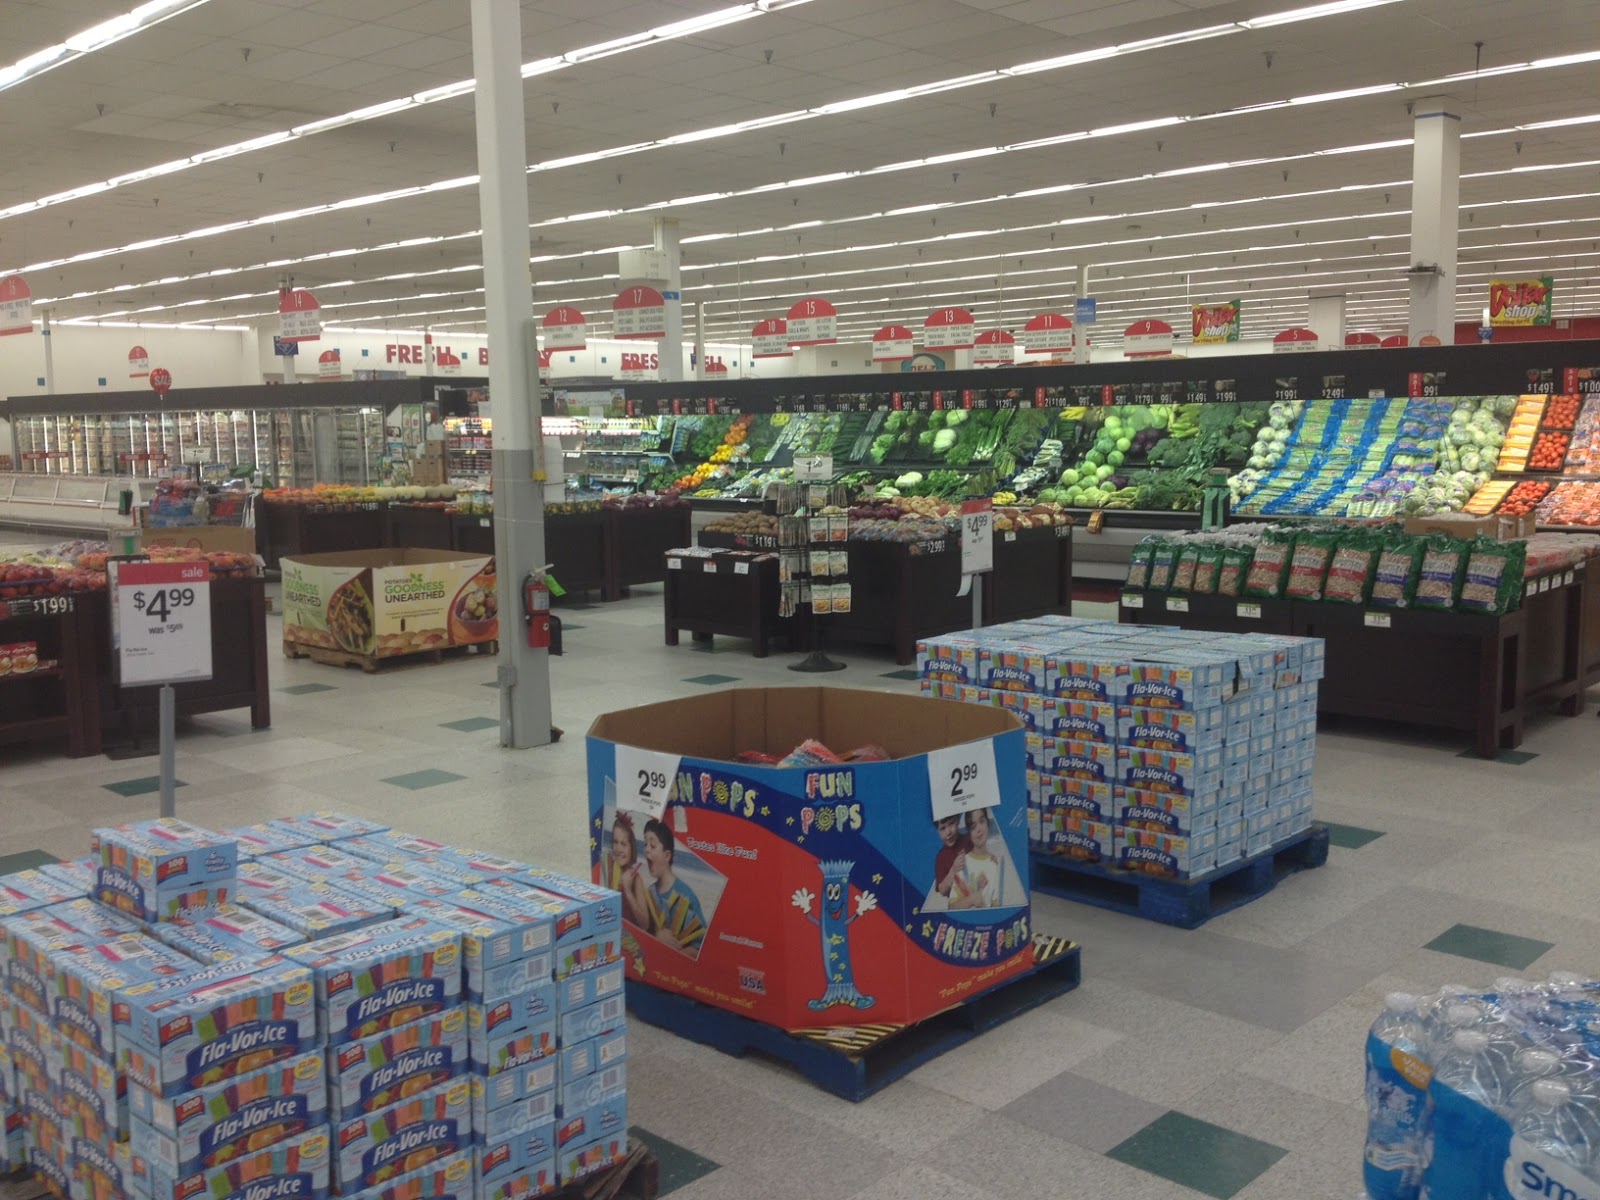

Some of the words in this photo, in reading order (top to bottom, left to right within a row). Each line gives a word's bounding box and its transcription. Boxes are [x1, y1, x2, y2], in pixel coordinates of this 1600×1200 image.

[294, 293, 302, 308] 14
[633, 289, 642, 304] 17
[1491, 283, 1550, 318] Dollar
[559, 309, 567, 322] 12
[806, 301, 816, 315] 15
[1504, 304, 1537, 318] shop
[944, 309, 954, 323] 13
[1044, 315, 1052, 327] 11
[767, 320, 776, 333] 10
[890, 327, 895, 338] 8
[1145, 321, 1151, 332] 9
[1204, 326, 1229, 337] shop
[991, 332, 996, 342] 6
[1293, 330, 1298, 340] 5
[1357, 335, 1362, 343] 3
[154, 375, 172, 386] SALE
[181, 566, 204, 578] sale
[384, 581, 445, 594] GOODNESS
[384, 590, 446, 604] UNEARTHED
[133, 588, 195, 623] $499
[148, 626, 165, 635] was
[1060, 678, 1101, 692] Fla-Vor-Ice
[1132, 683, 1178, 698] Fla-Vor-Ice
[1058, 718, 1100, 732] Fla-Vor-Ice
[1134, 727, 1180, 742] Fla-Vor-Ice
[1057, 757, 1099, 772] Fla-Vor-Ice
[637, 769, 666, 798] 299
[951, 763, 978, 797] 299
[1132, 768, 1178, 785] Fla-Vor-Ice
[806, 771, 853, 798] FUN
[700, 772, 757, 818] POPS
[1053, 795, 1095, 811] Fla-Vor-Ice
[801, 803, 862, 835] POPS
[1128, 807, 1173, 825] Fla-Vor-Ice
[1127, 848, 1172, 866] Fla-Vor-Ice
[933, 922, 990, 961] FREEZE
[996, 916, 1028, 956] POPS
[346, 934, 424, 962] Fla-Vor-Ice
[332, 972, 350, 985] 100
[742, 976, 765, 990] USA
[358, 982, 435, 1021] Fla-Vor-Ice
[169, 1015, 188, 1030] 100
[199, 1024, 287, 1067] Fla-Vor-Ice
[345, 1045, 365, 1061] 100
[370, 1050, 444, 1092] Fla-Vor-Ice
[183, 1096, 202, 1111] 100
[212, 1098, 298, 1146] Fla-Vor-Ice
[372, 1124, 449, 1166] Fla-Vor-Ice
[182, 1175, 204, 1191] 100
